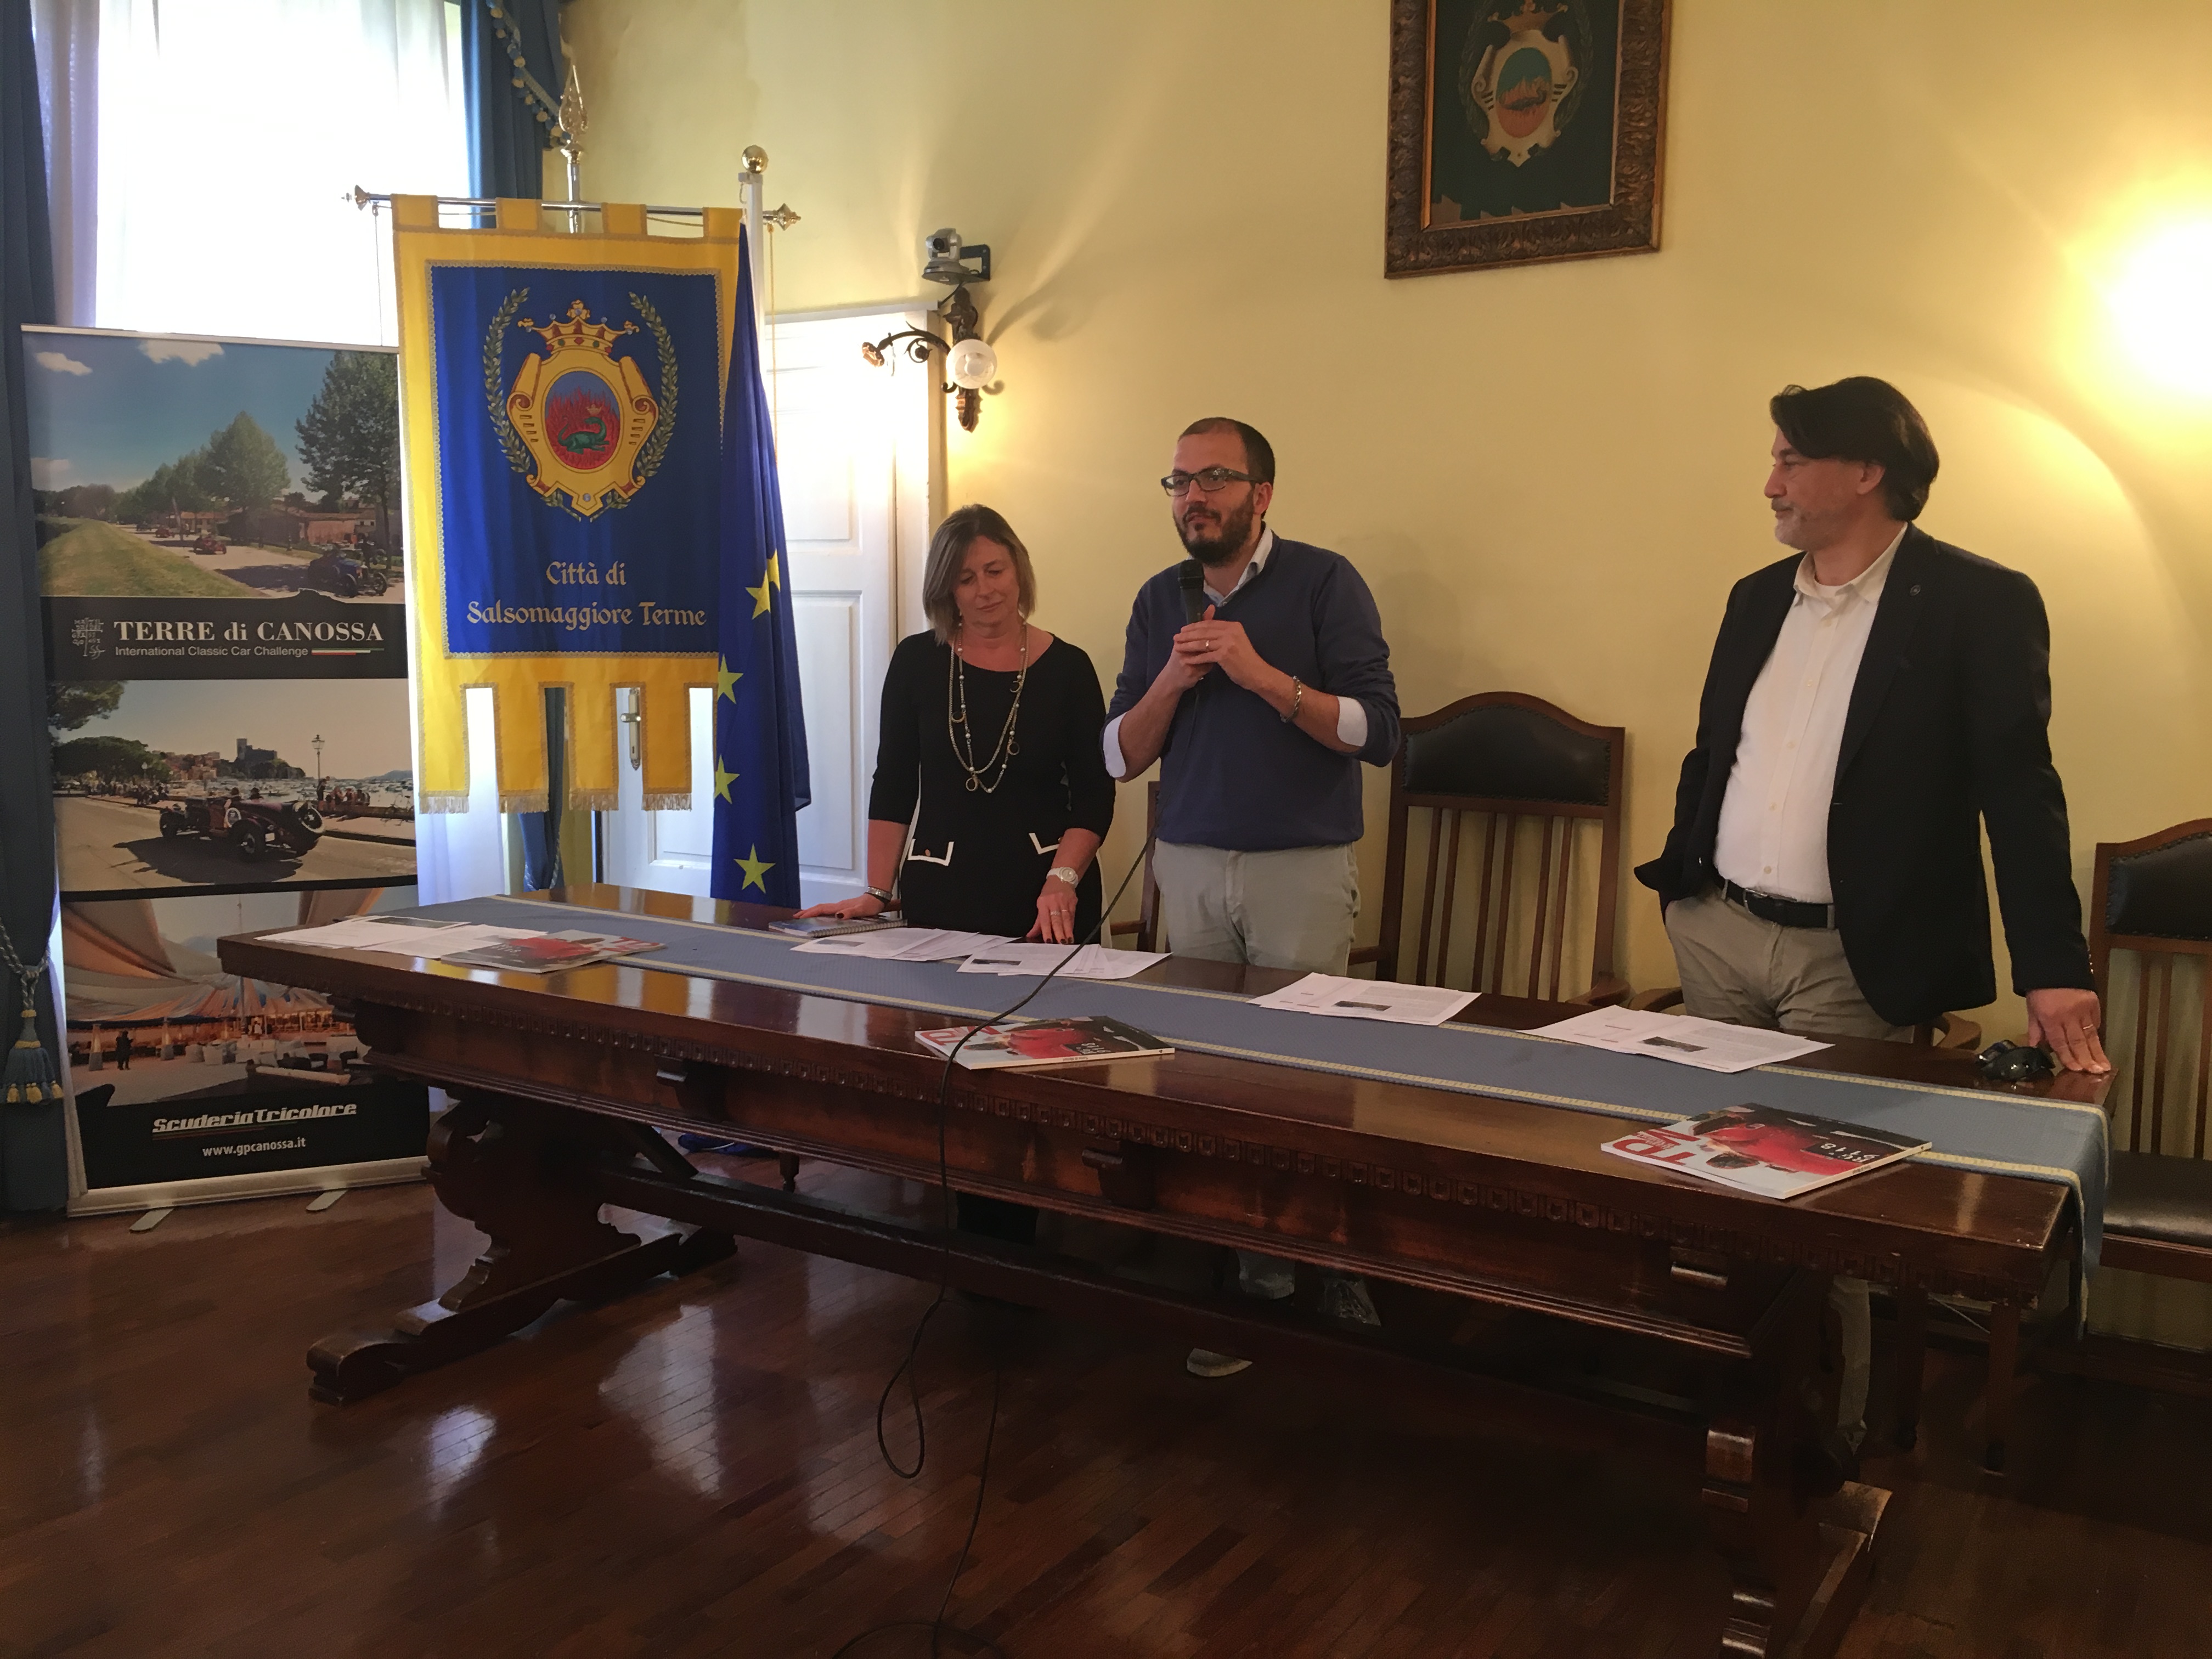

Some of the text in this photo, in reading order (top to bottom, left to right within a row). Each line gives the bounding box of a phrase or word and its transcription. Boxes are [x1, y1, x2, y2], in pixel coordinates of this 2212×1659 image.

[546, 561, 627, 586] Città di
[467, 599, 707, 631] Salsomaggiore Terme
[114, 621, 215, 642] TERRE
[224, 621, 247, 642] di
[257, 621, 383, 642] CANOSSA
[115, 646, 308, 658] International Classic Car Challenge
[202, 1136, 307, 1157] www.gpcanossa.it
